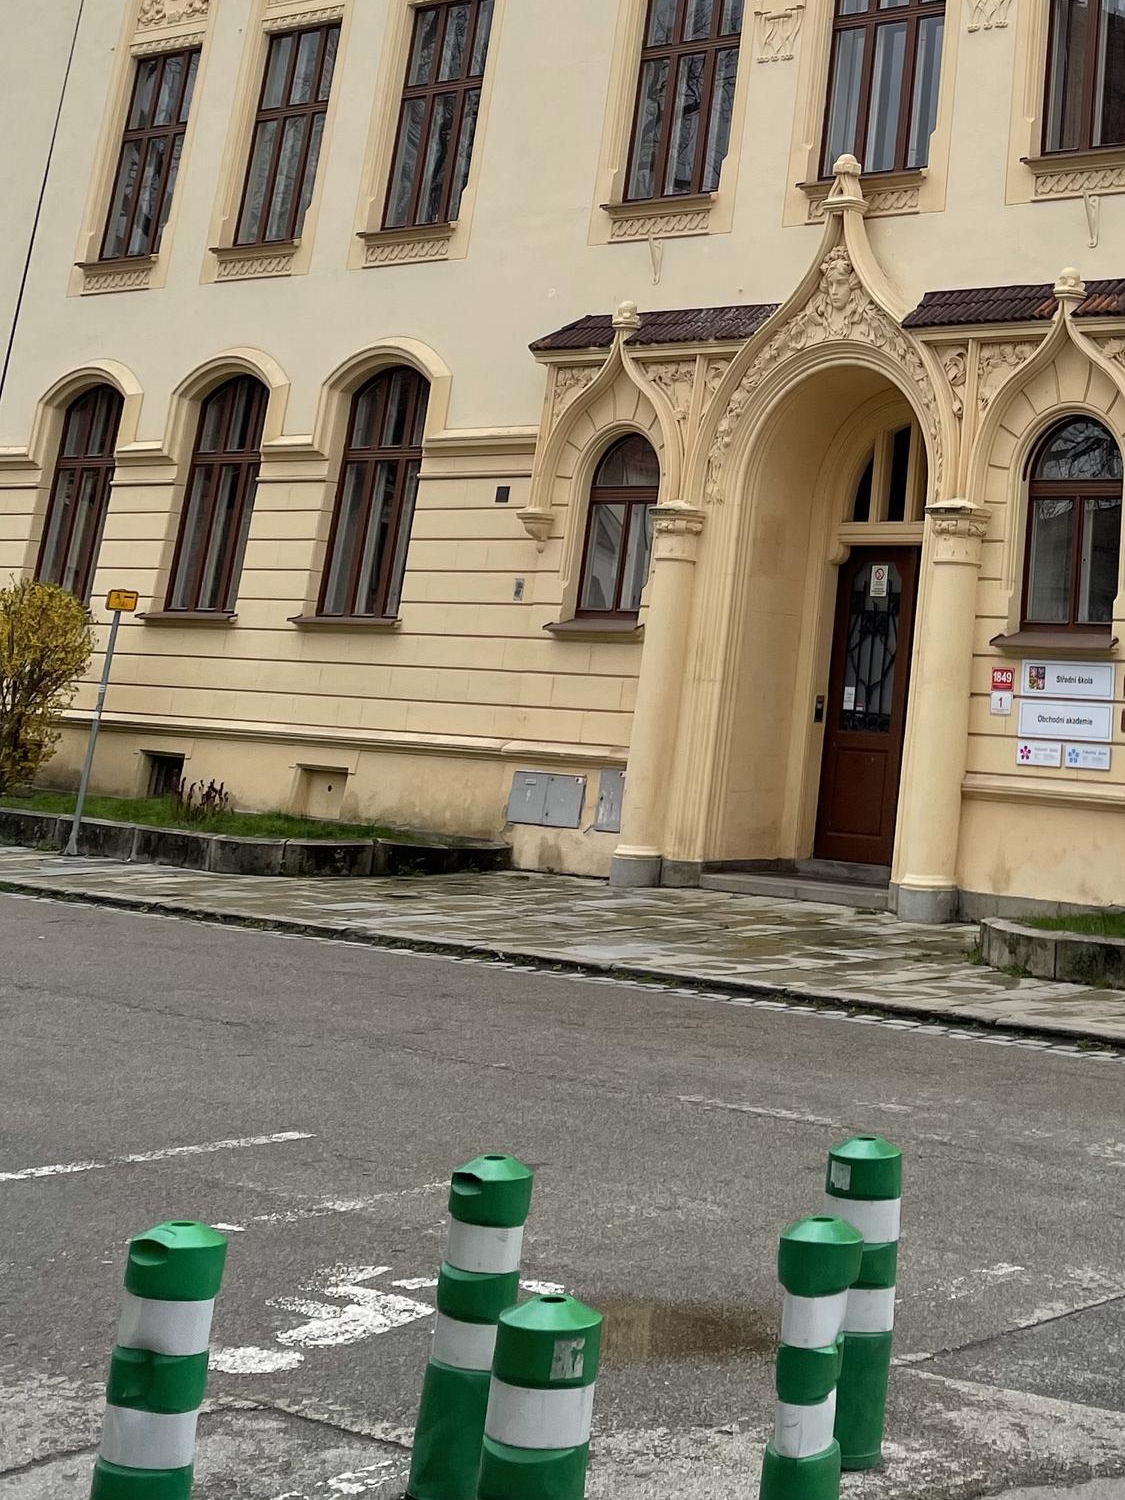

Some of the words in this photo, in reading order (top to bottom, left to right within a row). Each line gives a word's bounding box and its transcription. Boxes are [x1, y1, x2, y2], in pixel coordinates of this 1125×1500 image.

[993, 671, 1012, 683] 1849
[1077, 676, 1094, 685] škola
[998, 696, 1003, 708] 1
[1037, 715, 1065, 724] Obchodní
[1066, 717, 1093, 726] akademie
